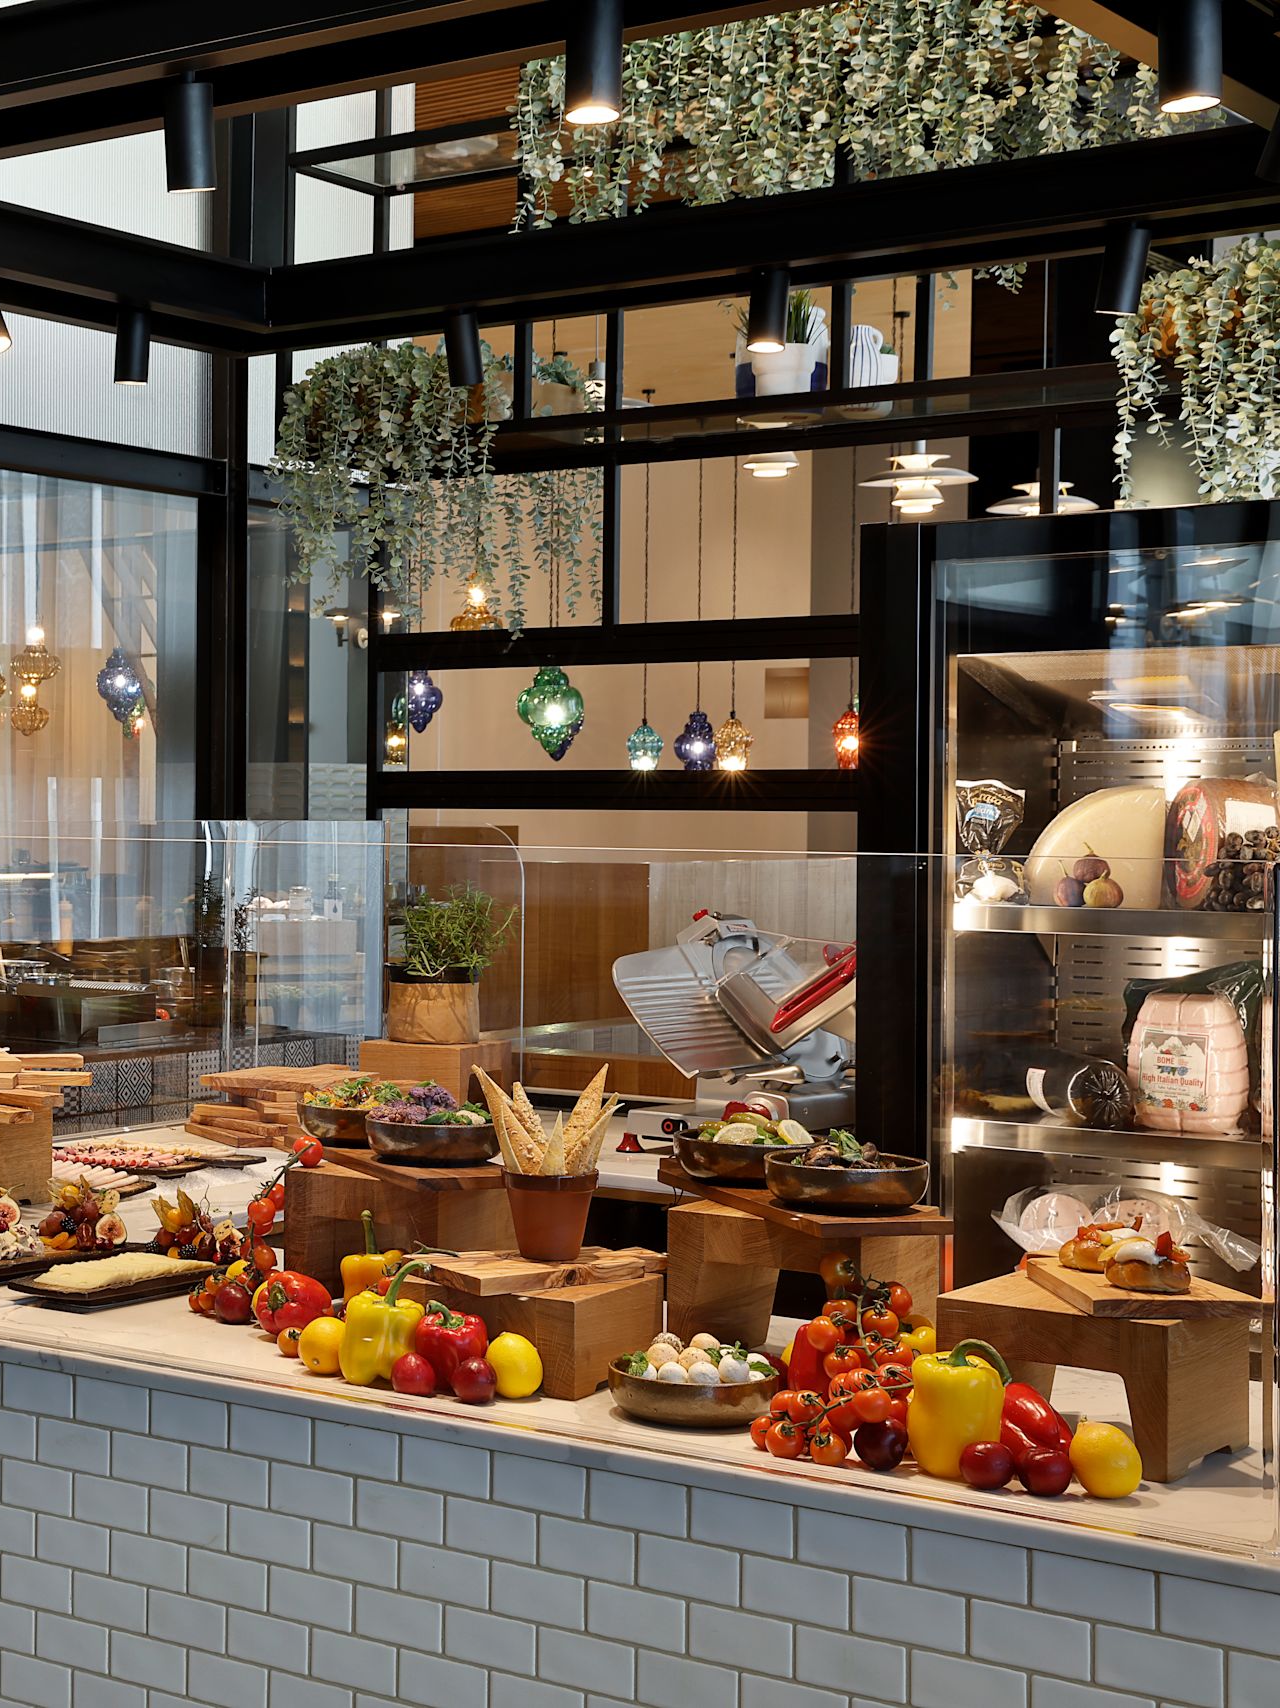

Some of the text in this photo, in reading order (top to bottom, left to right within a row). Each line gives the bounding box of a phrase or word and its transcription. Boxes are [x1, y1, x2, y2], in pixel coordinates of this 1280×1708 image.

[1141, 1072, 1204, 1088] High Italian Quality
